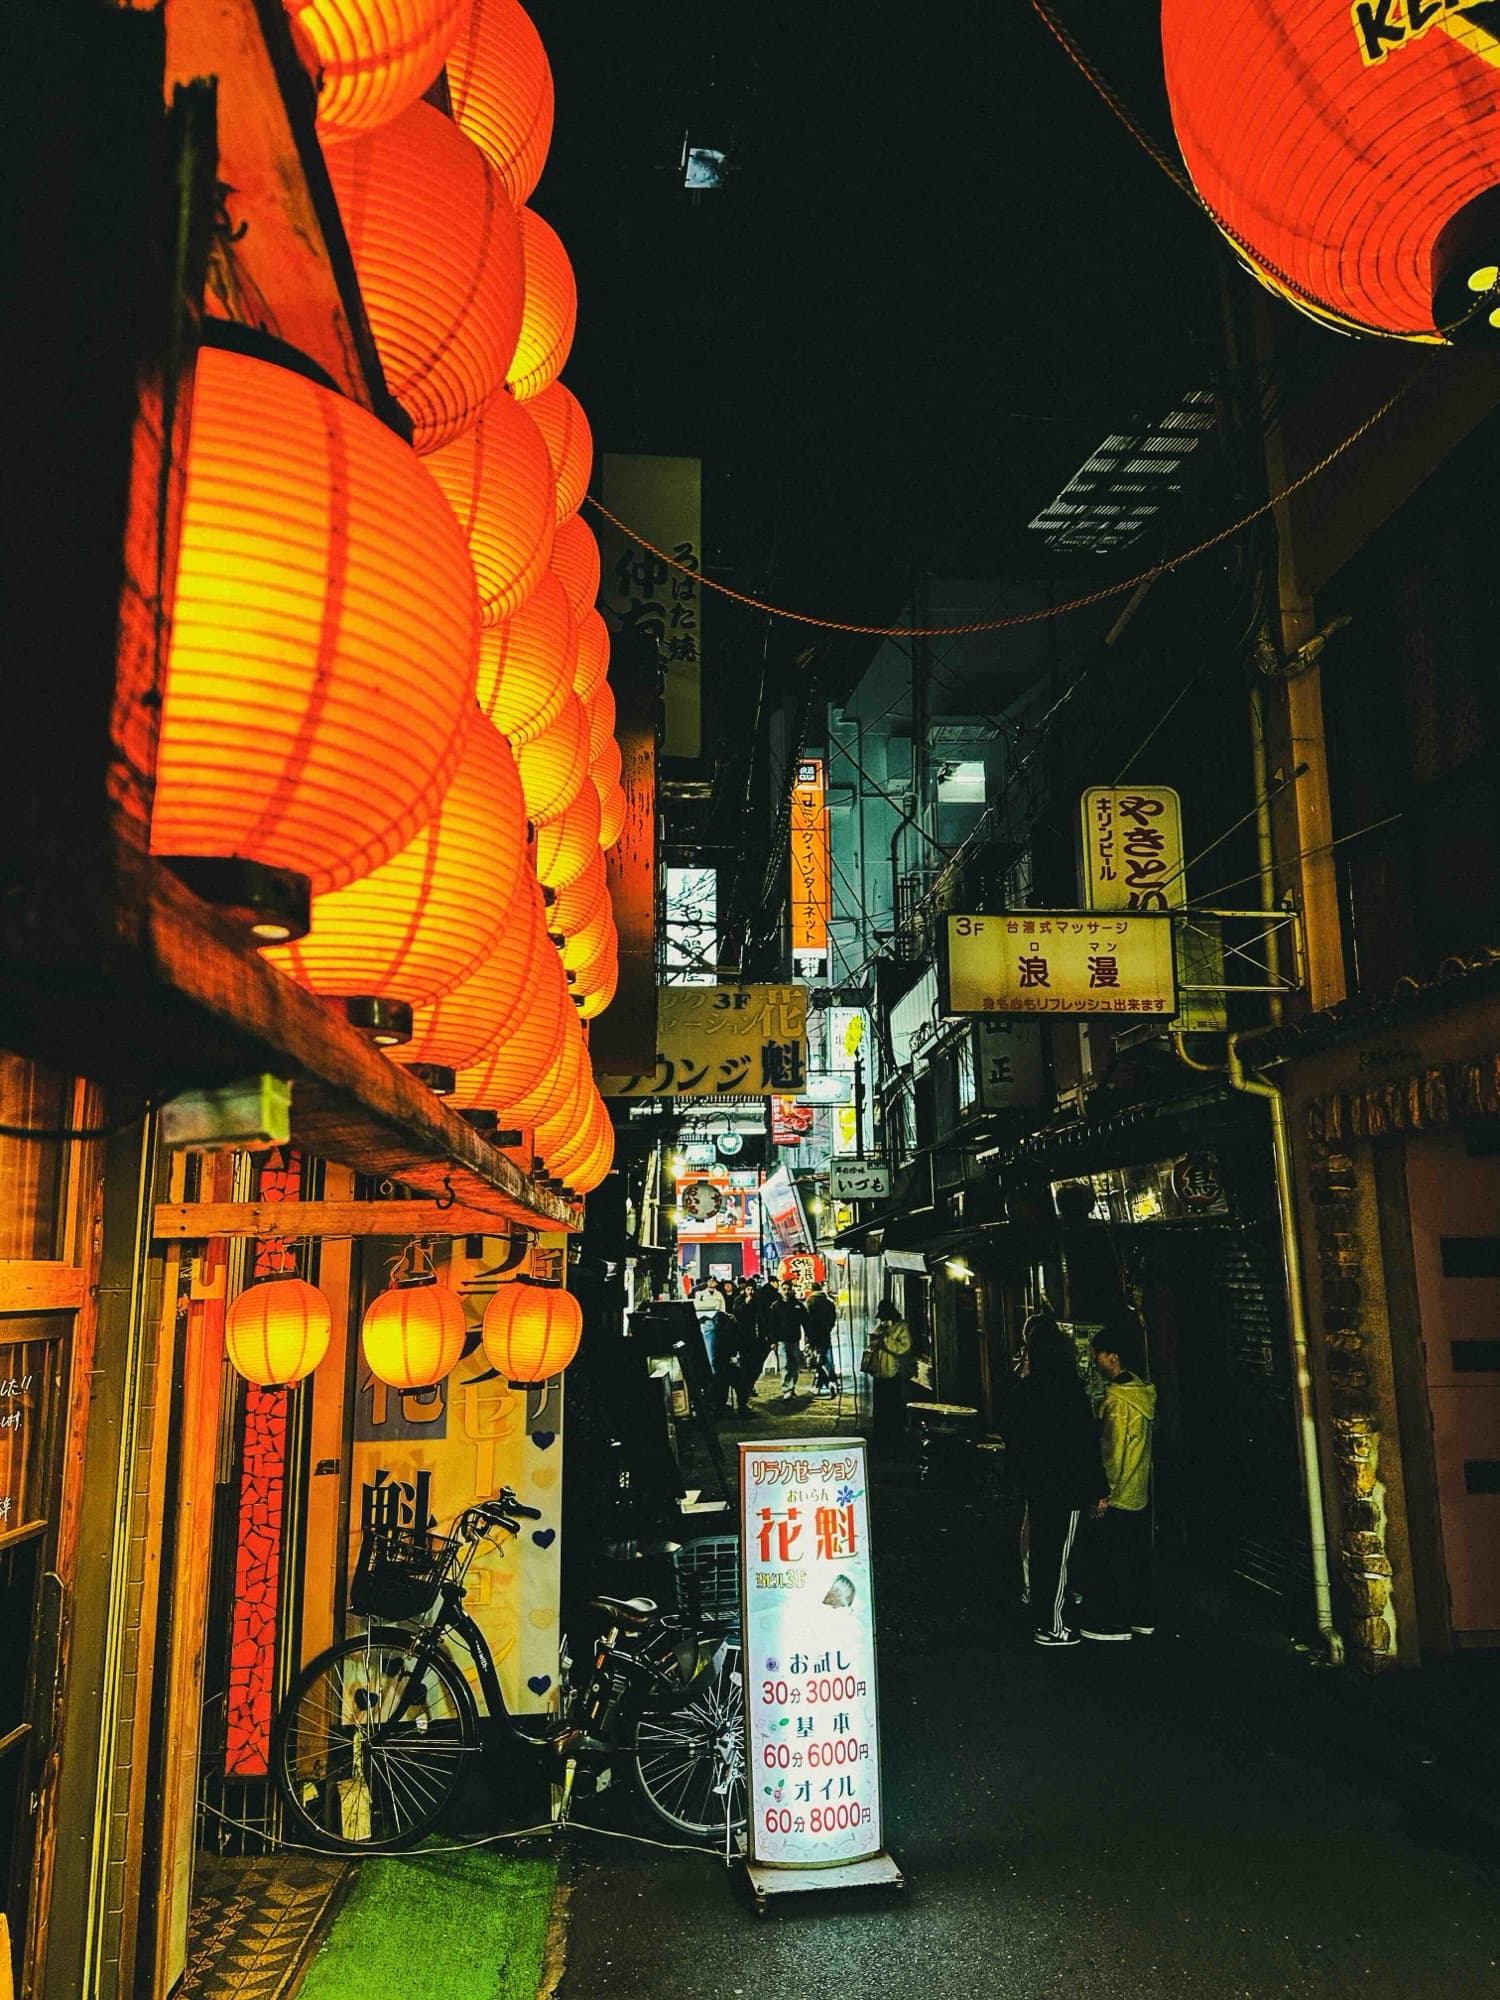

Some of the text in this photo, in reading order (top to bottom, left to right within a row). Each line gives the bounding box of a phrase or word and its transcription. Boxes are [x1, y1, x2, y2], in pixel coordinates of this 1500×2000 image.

[1096, 798, 1117, 880] キリンビール
[956, 917, 984, 936] 3F
[712, 992, 751, 1010] 3F
[757, 989, 806, 1089] 花魁
[618, 1054, 752, 1094] ウンジ
[752, 1458, 857, 1485] リラクゼーション
[756, 1504, 860, 1562] 花魁
[796, 1713, 849, 1738] 基本
[795, 1776, 856, 1802] オイル
